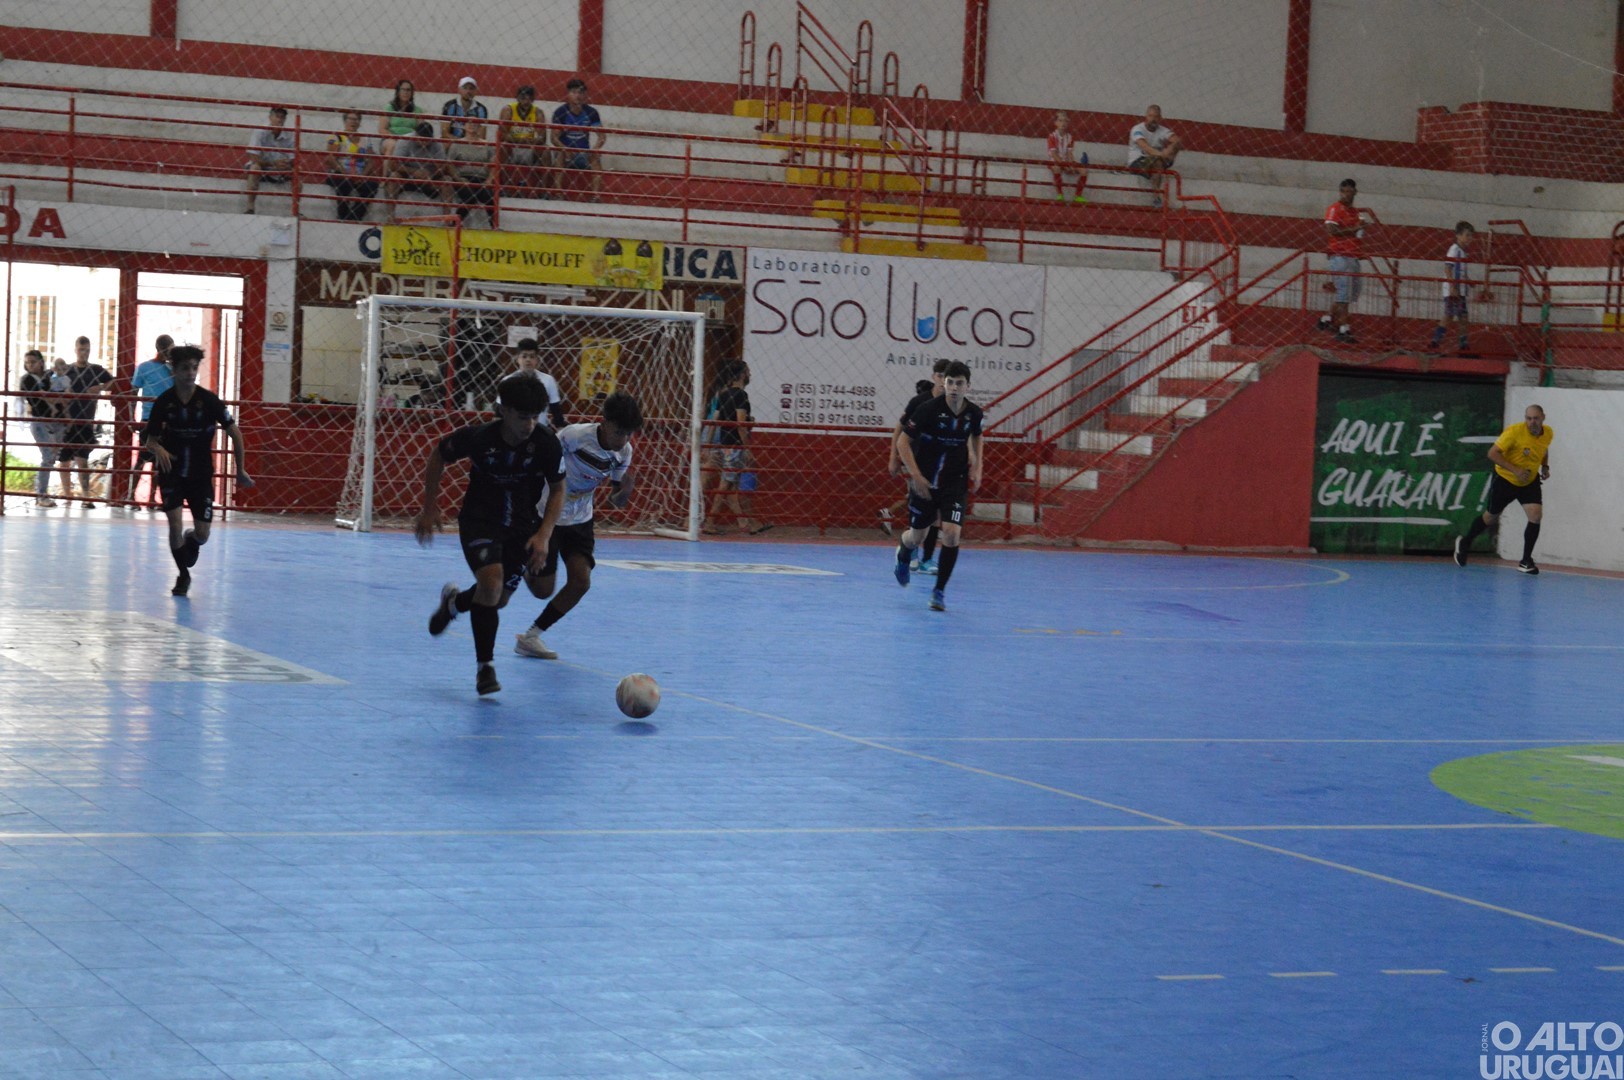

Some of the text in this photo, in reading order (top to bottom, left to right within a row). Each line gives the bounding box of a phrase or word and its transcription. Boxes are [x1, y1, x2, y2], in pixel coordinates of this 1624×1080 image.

[520, 250, 586, 268] WOLFF
[752, 256, 871, 276] Laboratório
[750, 264, 1036, 348] São Lucas
[795, 383, 816, 396] (55)
[794, 398, 816, 410] (55)
[794, 412, 815, 425] (55)
[818, 413, 826, 423] 9
[1321, 411, 1445, 457] AQUI É
[1317, 467, 1473, 511] GUARANI
[951, 510, 962, 523] 10
